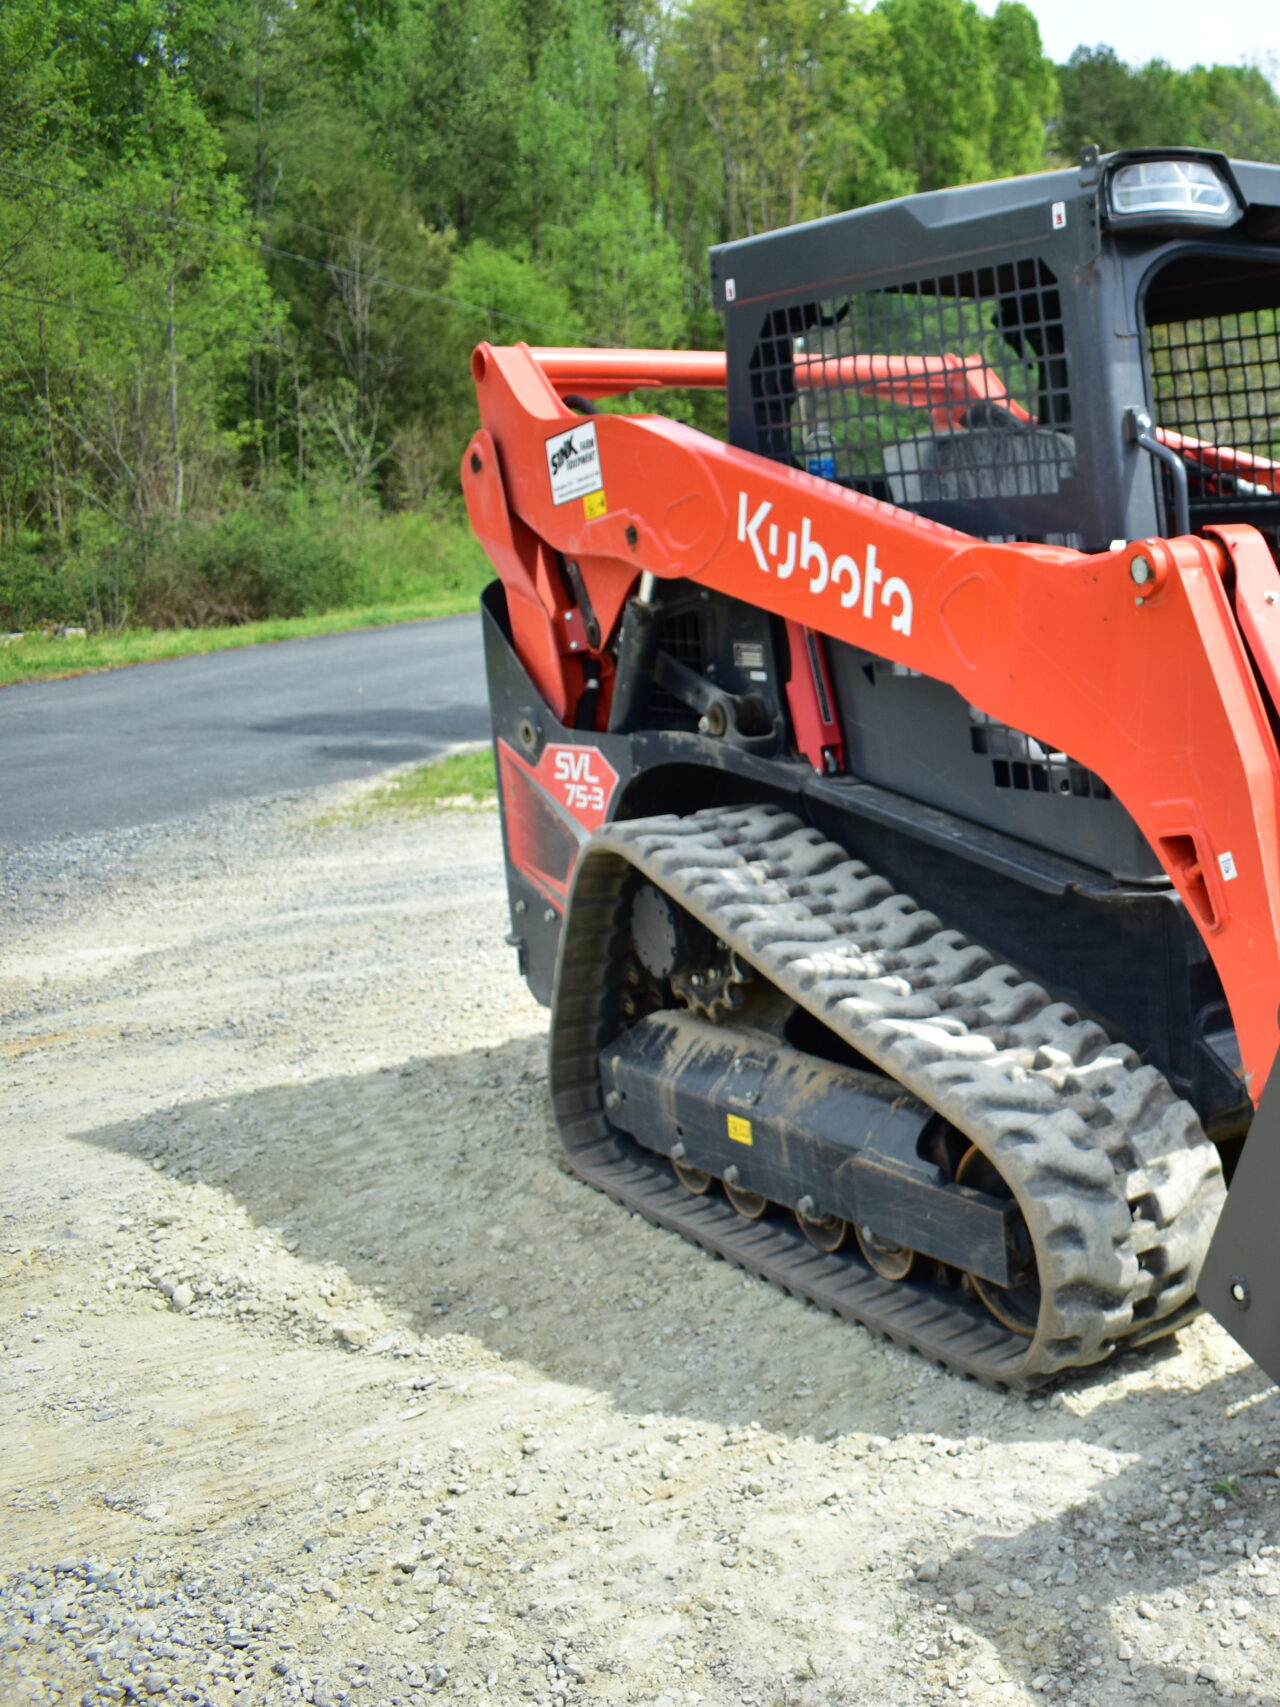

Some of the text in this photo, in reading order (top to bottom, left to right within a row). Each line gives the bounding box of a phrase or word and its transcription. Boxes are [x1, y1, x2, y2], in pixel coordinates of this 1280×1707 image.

[737, 491, 913, 637] Kubota
[554, 751, 600, 784] SVL
[564, 783, 605, 811] 75-3
